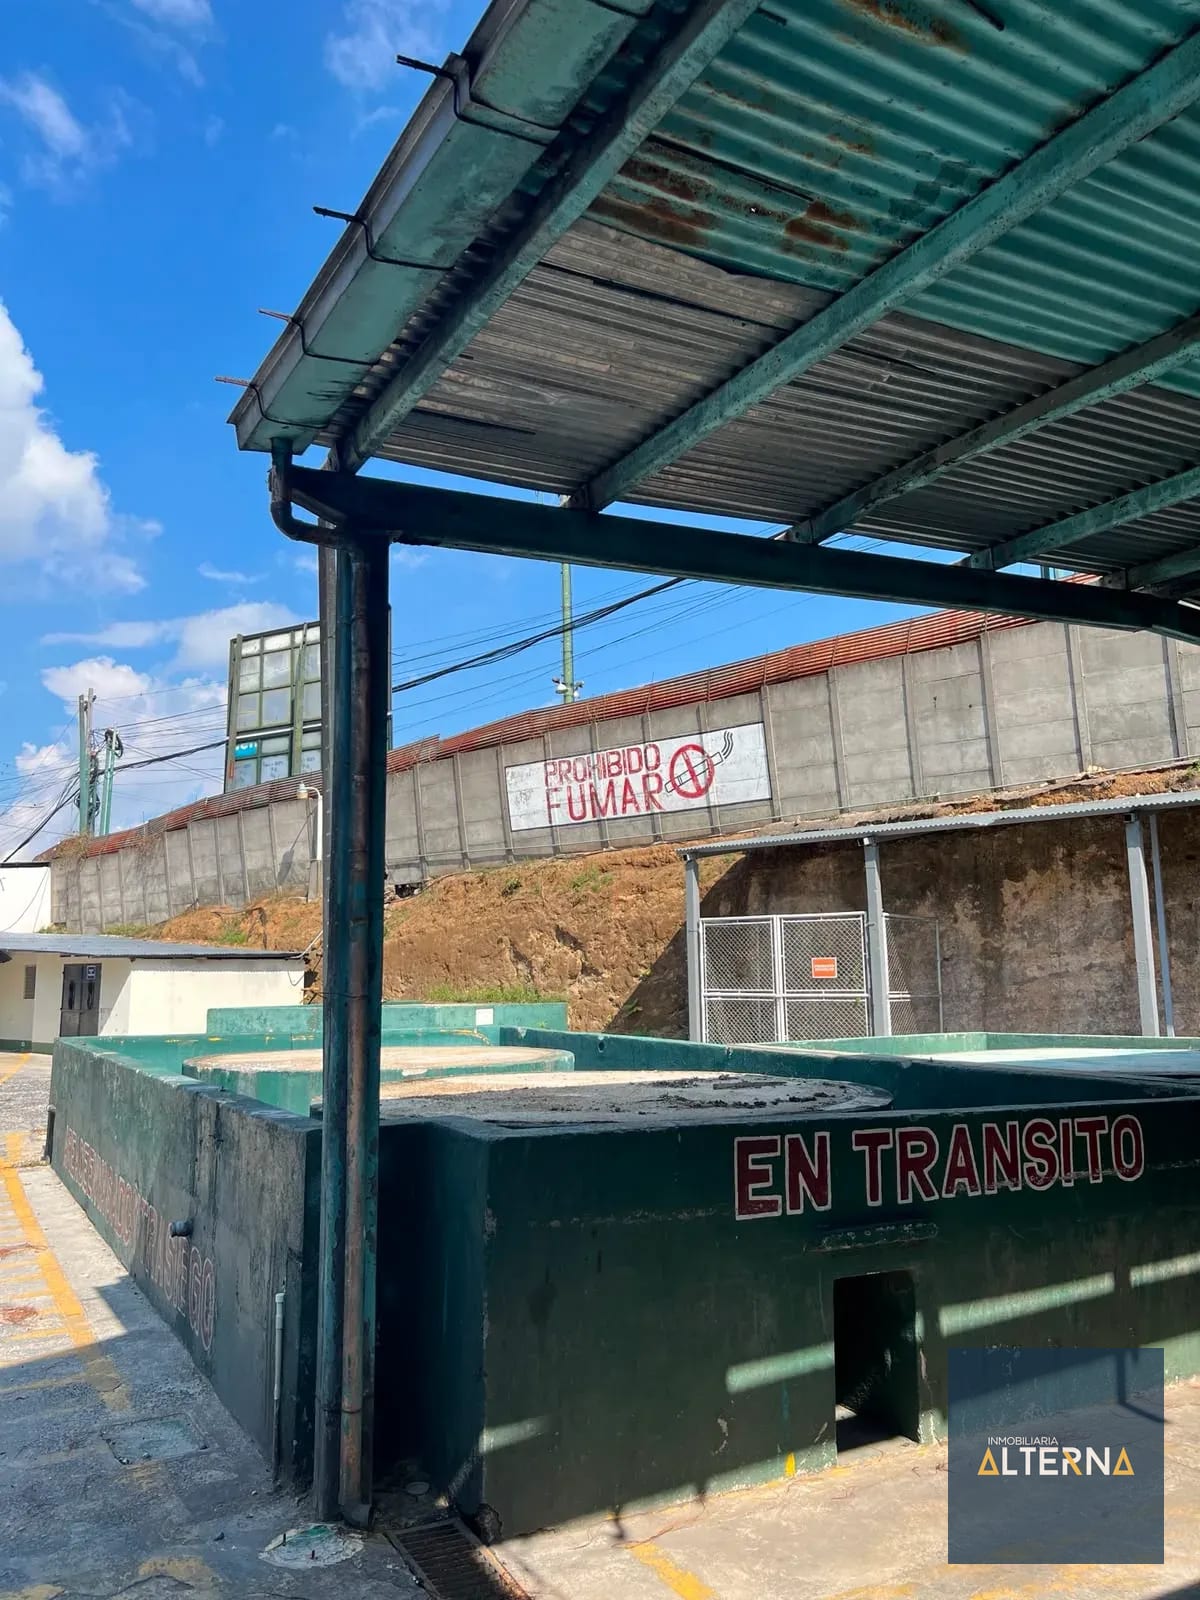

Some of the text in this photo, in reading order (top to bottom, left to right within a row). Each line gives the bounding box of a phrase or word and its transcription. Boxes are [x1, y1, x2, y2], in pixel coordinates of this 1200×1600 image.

[544, 743, 661, 787] PROHIBIDO
[545, 772, 666, 824] FUMAR
[734, 1114, 1145, 1221] EN TRANSITO
